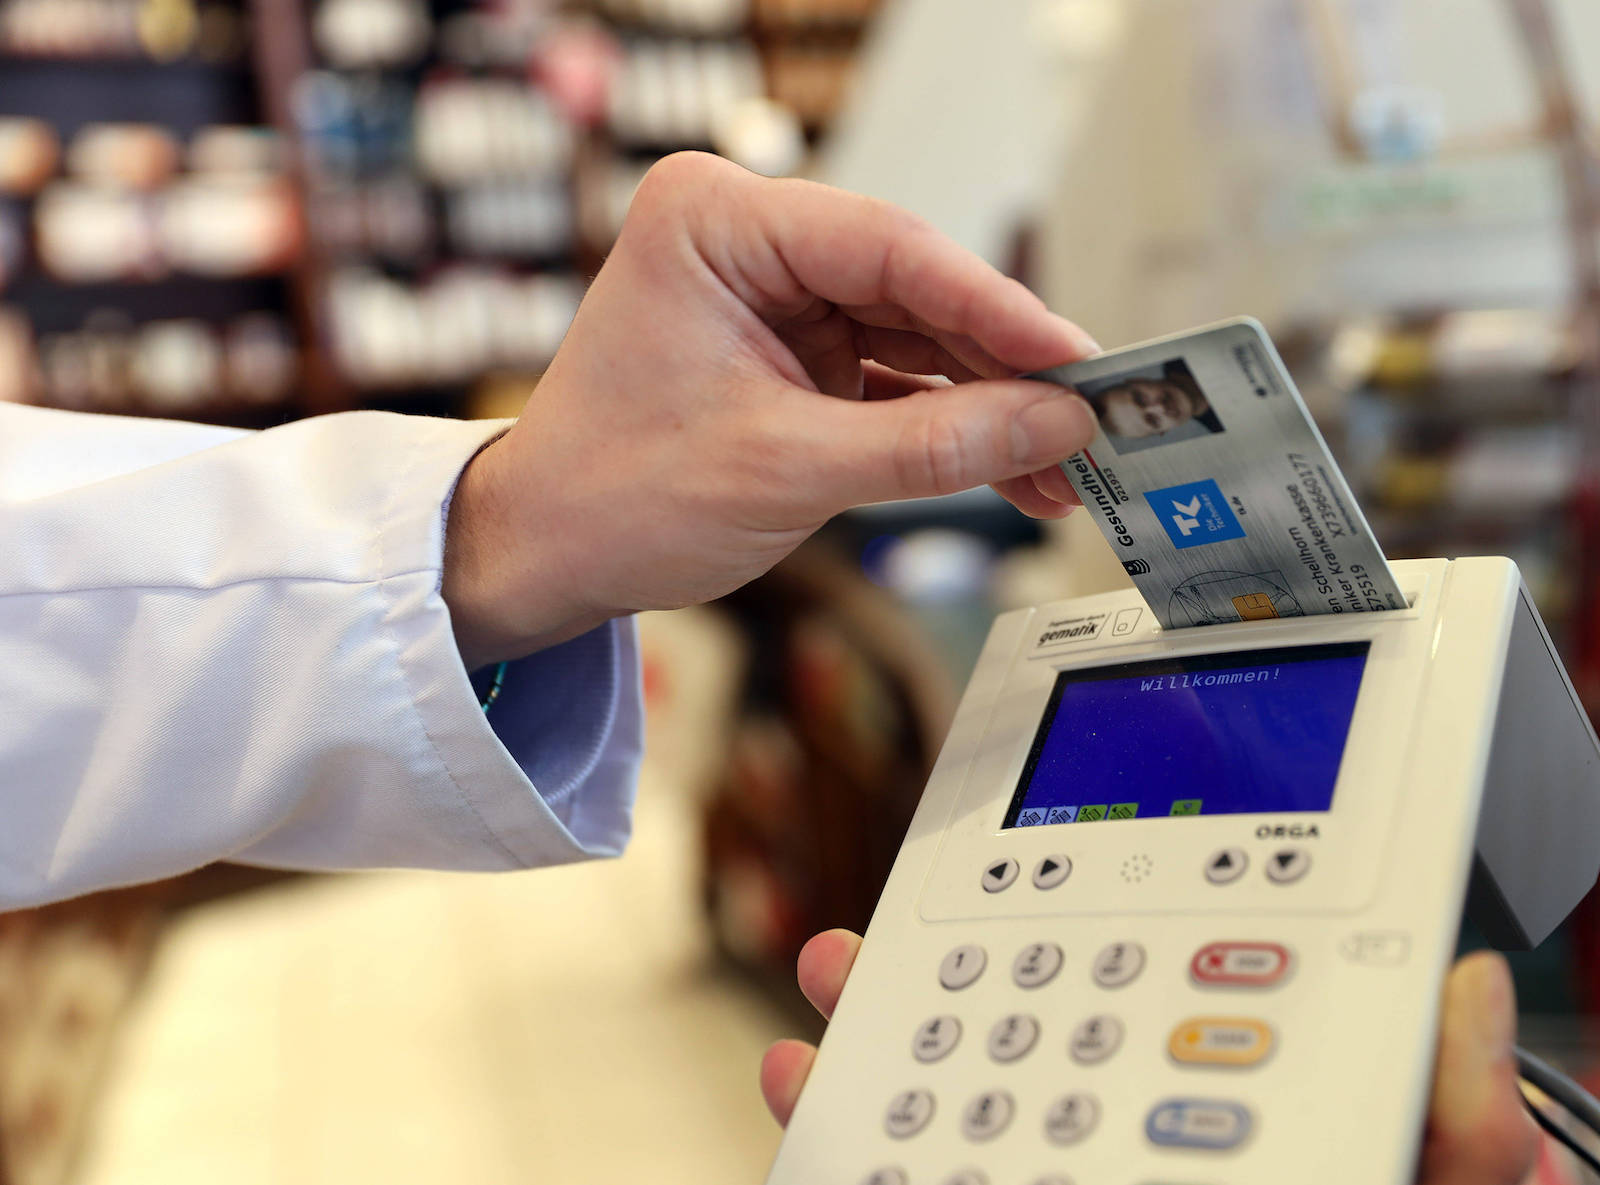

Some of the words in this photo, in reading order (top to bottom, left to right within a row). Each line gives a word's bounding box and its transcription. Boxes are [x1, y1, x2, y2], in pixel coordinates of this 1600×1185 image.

[1103, 467, 1129, 502] 021933
[1171, 495, 1201, 536] TK
[1205, 518, 1217, 531] Die
[1286, 484, 1344, 576] Krankenkasse
[1289, 527, 1333, 595] Schellhorn
[1037, 622, 1100, 648] gematik
[1140, 668, 1280, 692] Willkommen!
[1255, 824, 1320, 840] ORGA
[955, 952, 965, 969] 1
[1029, 943, 1045, 964] 2
